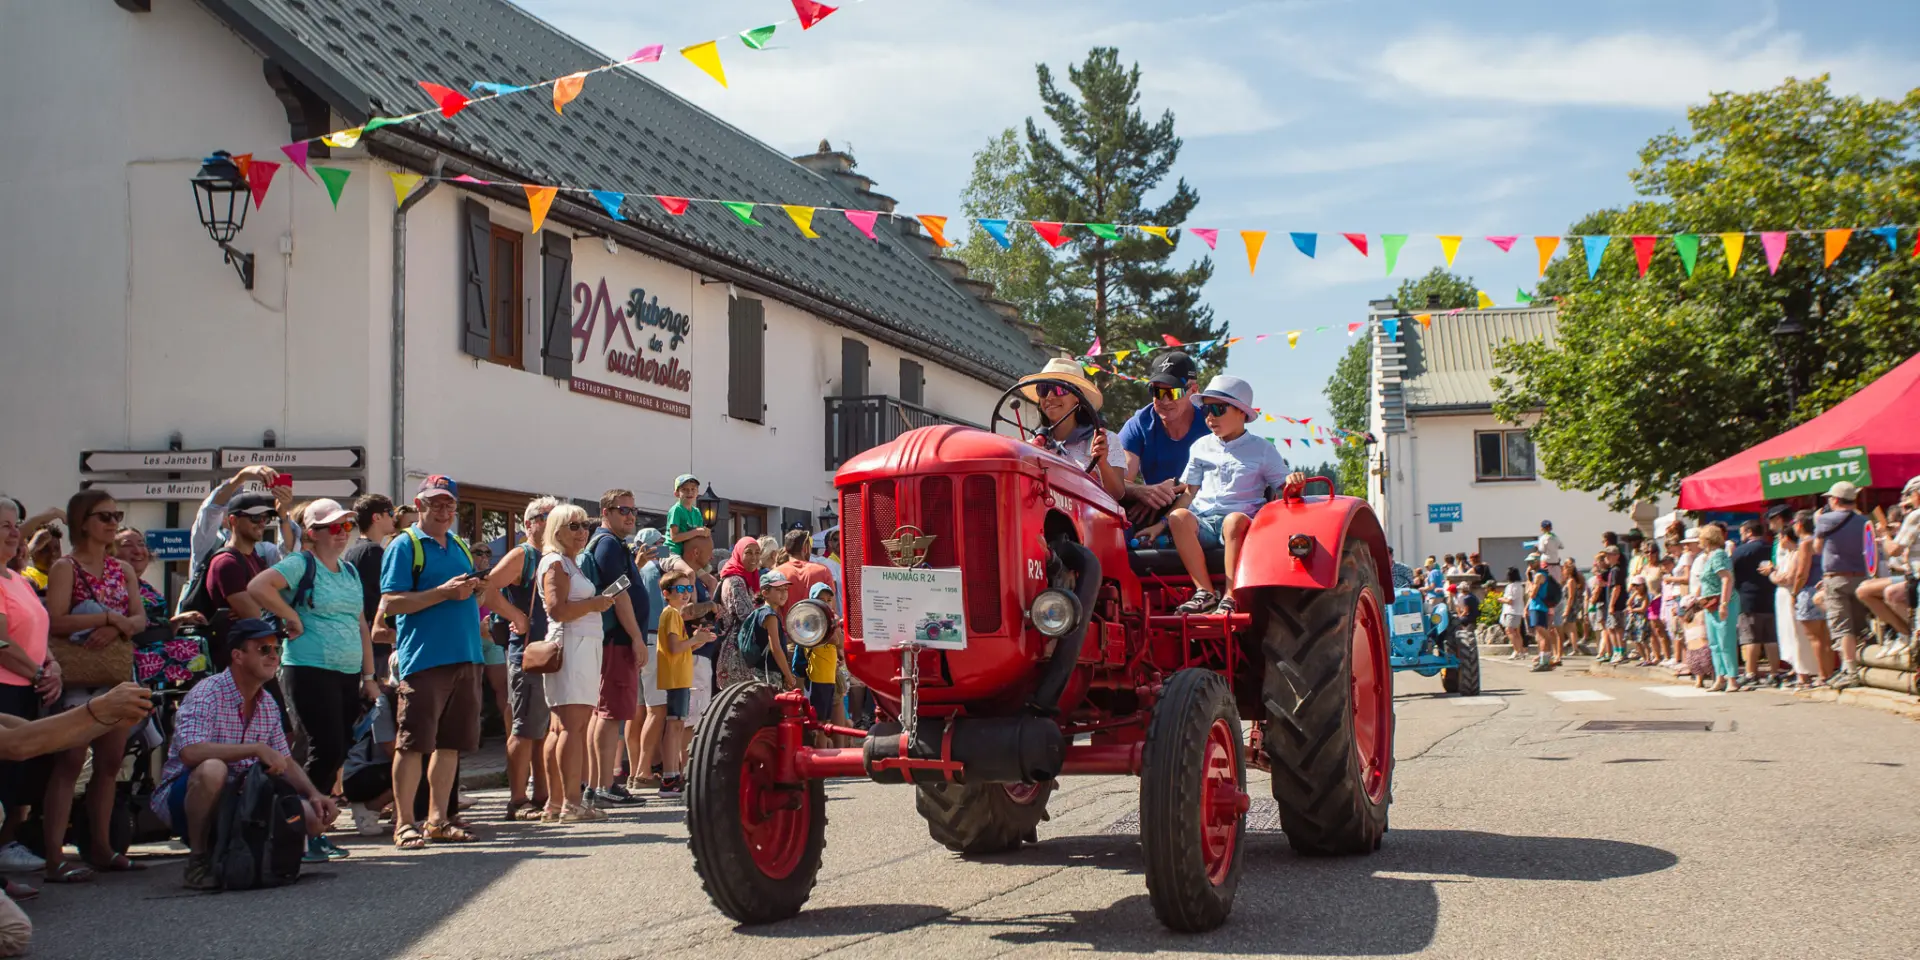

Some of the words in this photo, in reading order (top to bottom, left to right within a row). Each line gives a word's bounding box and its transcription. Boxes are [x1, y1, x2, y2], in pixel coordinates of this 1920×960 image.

[627, 288, 691, 351] Auberge
[650, 334, 664, 353] des
[573, 380, 611, 397] RESTAURANT
[614, 390, 622, 400] DE
[625, 392, 653, 408] MONTAGNE
[655, 400, 660, 408] &
[662, 401, 688, 416] CHAMBRES
[144, 454, 160, 465] Les
[164, 454, 208, 465] Jambets
[228, 452, 245, 462] Les
[251, 452, 297, 462] Rambins
[1768, 460, 1861, 487] BUVETTE
[146, 484, 164, 494] Les
[166, 483, 206, 494] Martins
[882, 572, 918, 582] HANOMAG
[920, 573, 926, 582] R
[928, 574, 936, 582] 24
[1028, 559, 1034, 579] R
[1034, 560, 1044, 580] 24
